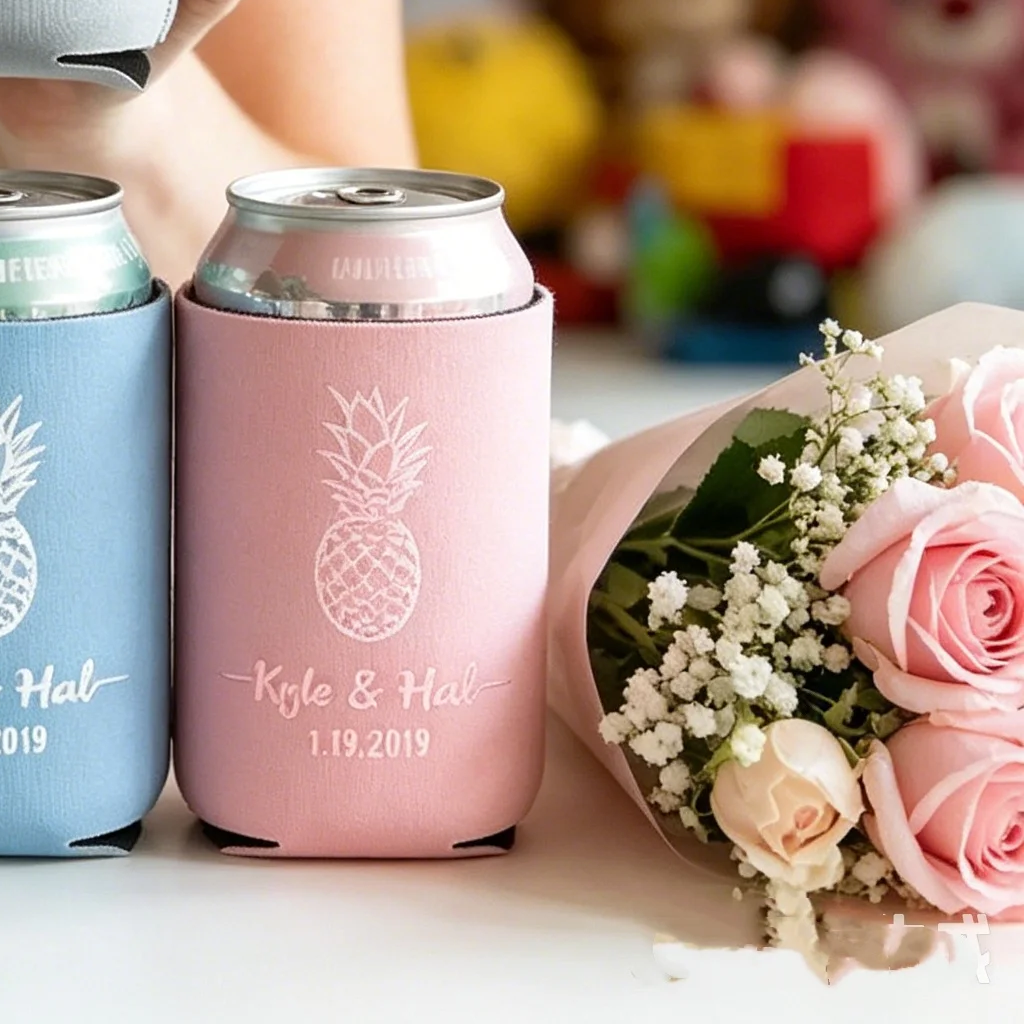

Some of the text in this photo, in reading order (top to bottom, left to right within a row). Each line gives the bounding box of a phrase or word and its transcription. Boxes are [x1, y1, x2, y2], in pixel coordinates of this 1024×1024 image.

[15, 658, 129, 709] Hal
[254, 659, 512, 719] Kyle & Hal
[309, 728, 431, 759] 1.19.2019
